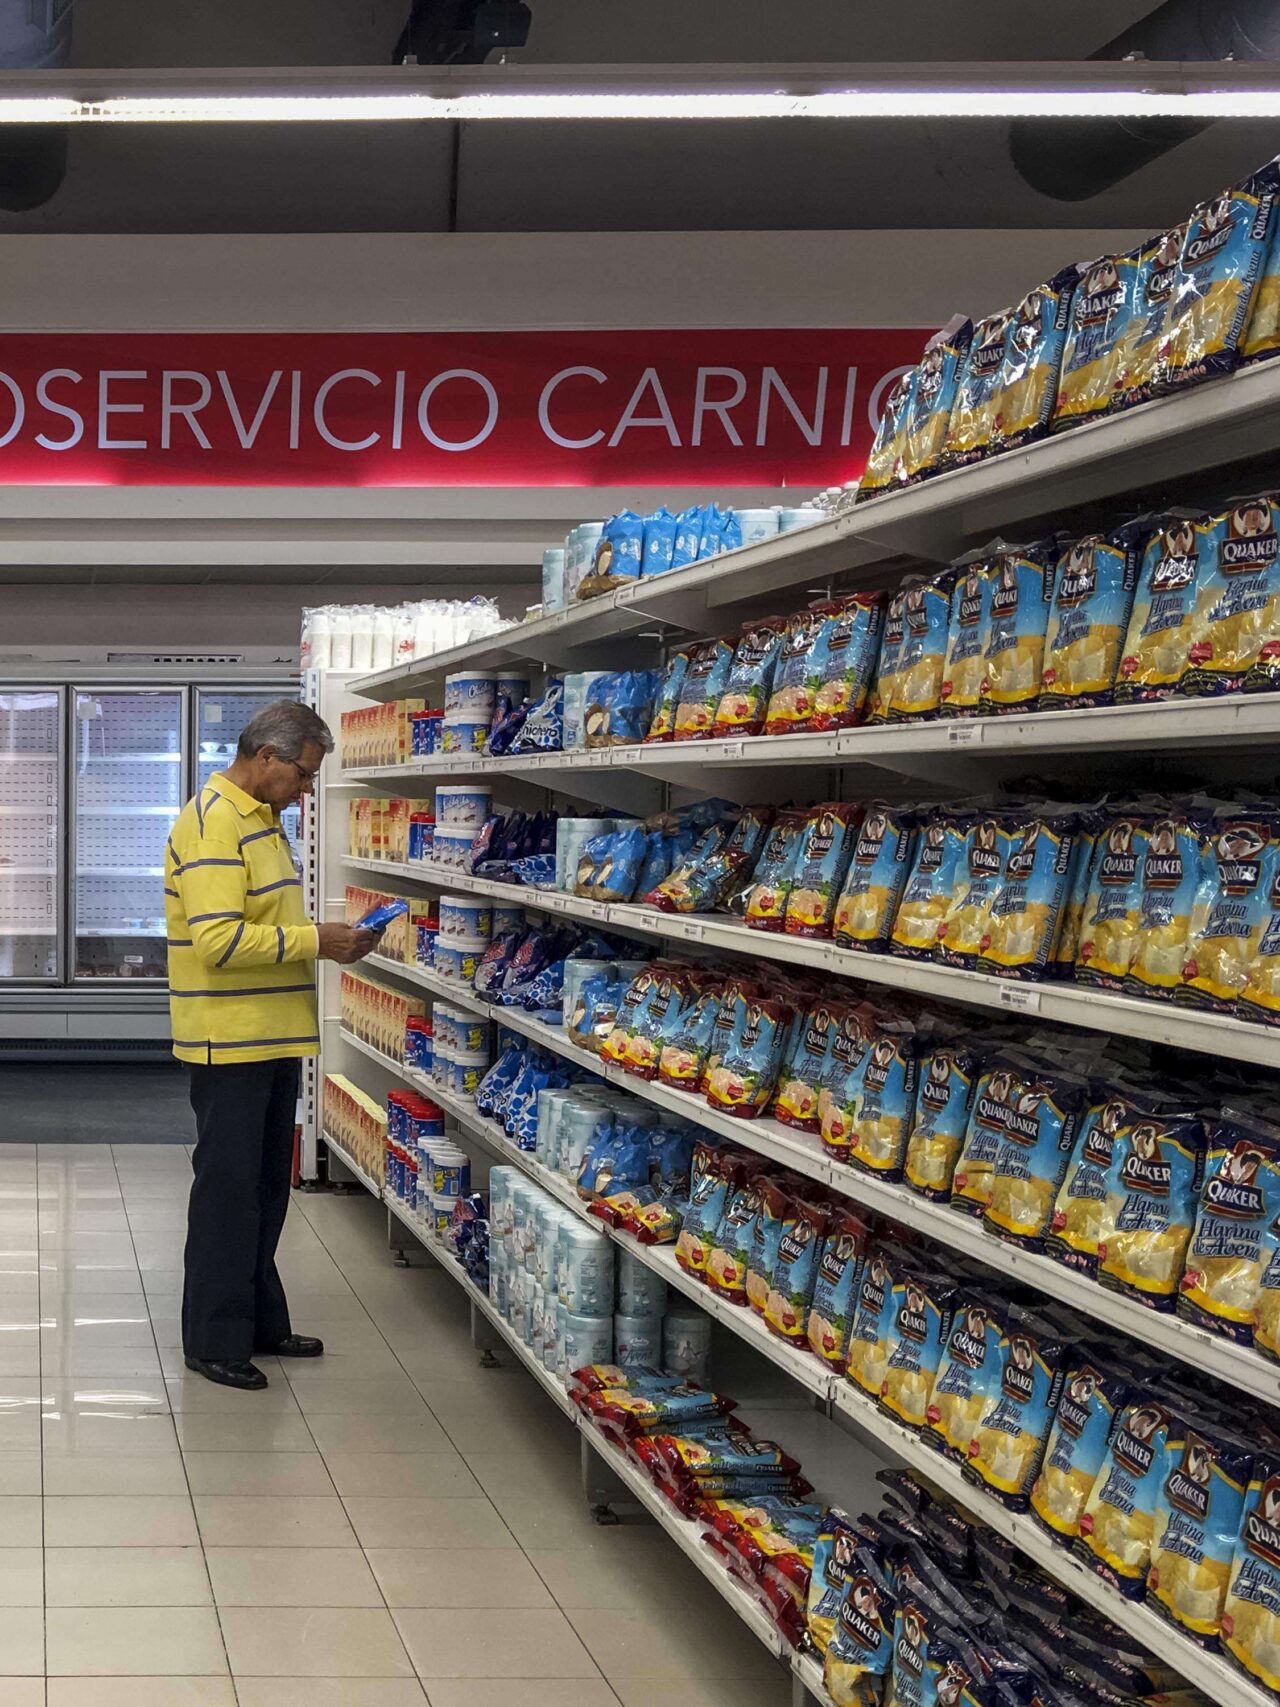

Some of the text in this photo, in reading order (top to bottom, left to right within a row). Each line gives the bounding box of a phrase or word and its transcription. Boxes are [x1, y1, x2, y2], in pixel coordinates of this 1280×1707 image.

[1253, 194, 1273, 240] QUAKER
[1055, 288, 1072, 330] QUAKER
[1222, 537, 1280, 562] QUAKER
[1123, 551, 1138, 592] QUAKER
[896, 830, 910, 862] QUAKER
[1056, 836, 1071, 875] QUAKER
[1103, 857, 1135, 873] QUAKER
[1146, 861, 1182, 878] QUAKER
[773, 1021, 785, 1048] QUAKER
[904, 1060, 916, 1092] QUAKER
[1060, 1114, 1075, 1151] QUAKER
[1208, 1179, 1261, 1210] QUAKER
[1200, 1218, 1261, 1242] Harina
[823, 1254, 846, 1274] QUAKE
[1048, 1371, 1065, 1407] QUAKER
[1058, 1399, 1090, 1428] QUAKER
[1116, 1432, 1152, 1468] QUAKER
[1168, 1474, 1207, 1510] QUAKER
[1169, 1511, 1205, 1545] Harina
[1248, 1517, 1280, 1549] QUA
[841, 1601, 881, 1646] QUAKER
[898, 1638, 923, 1671] QUAKE
